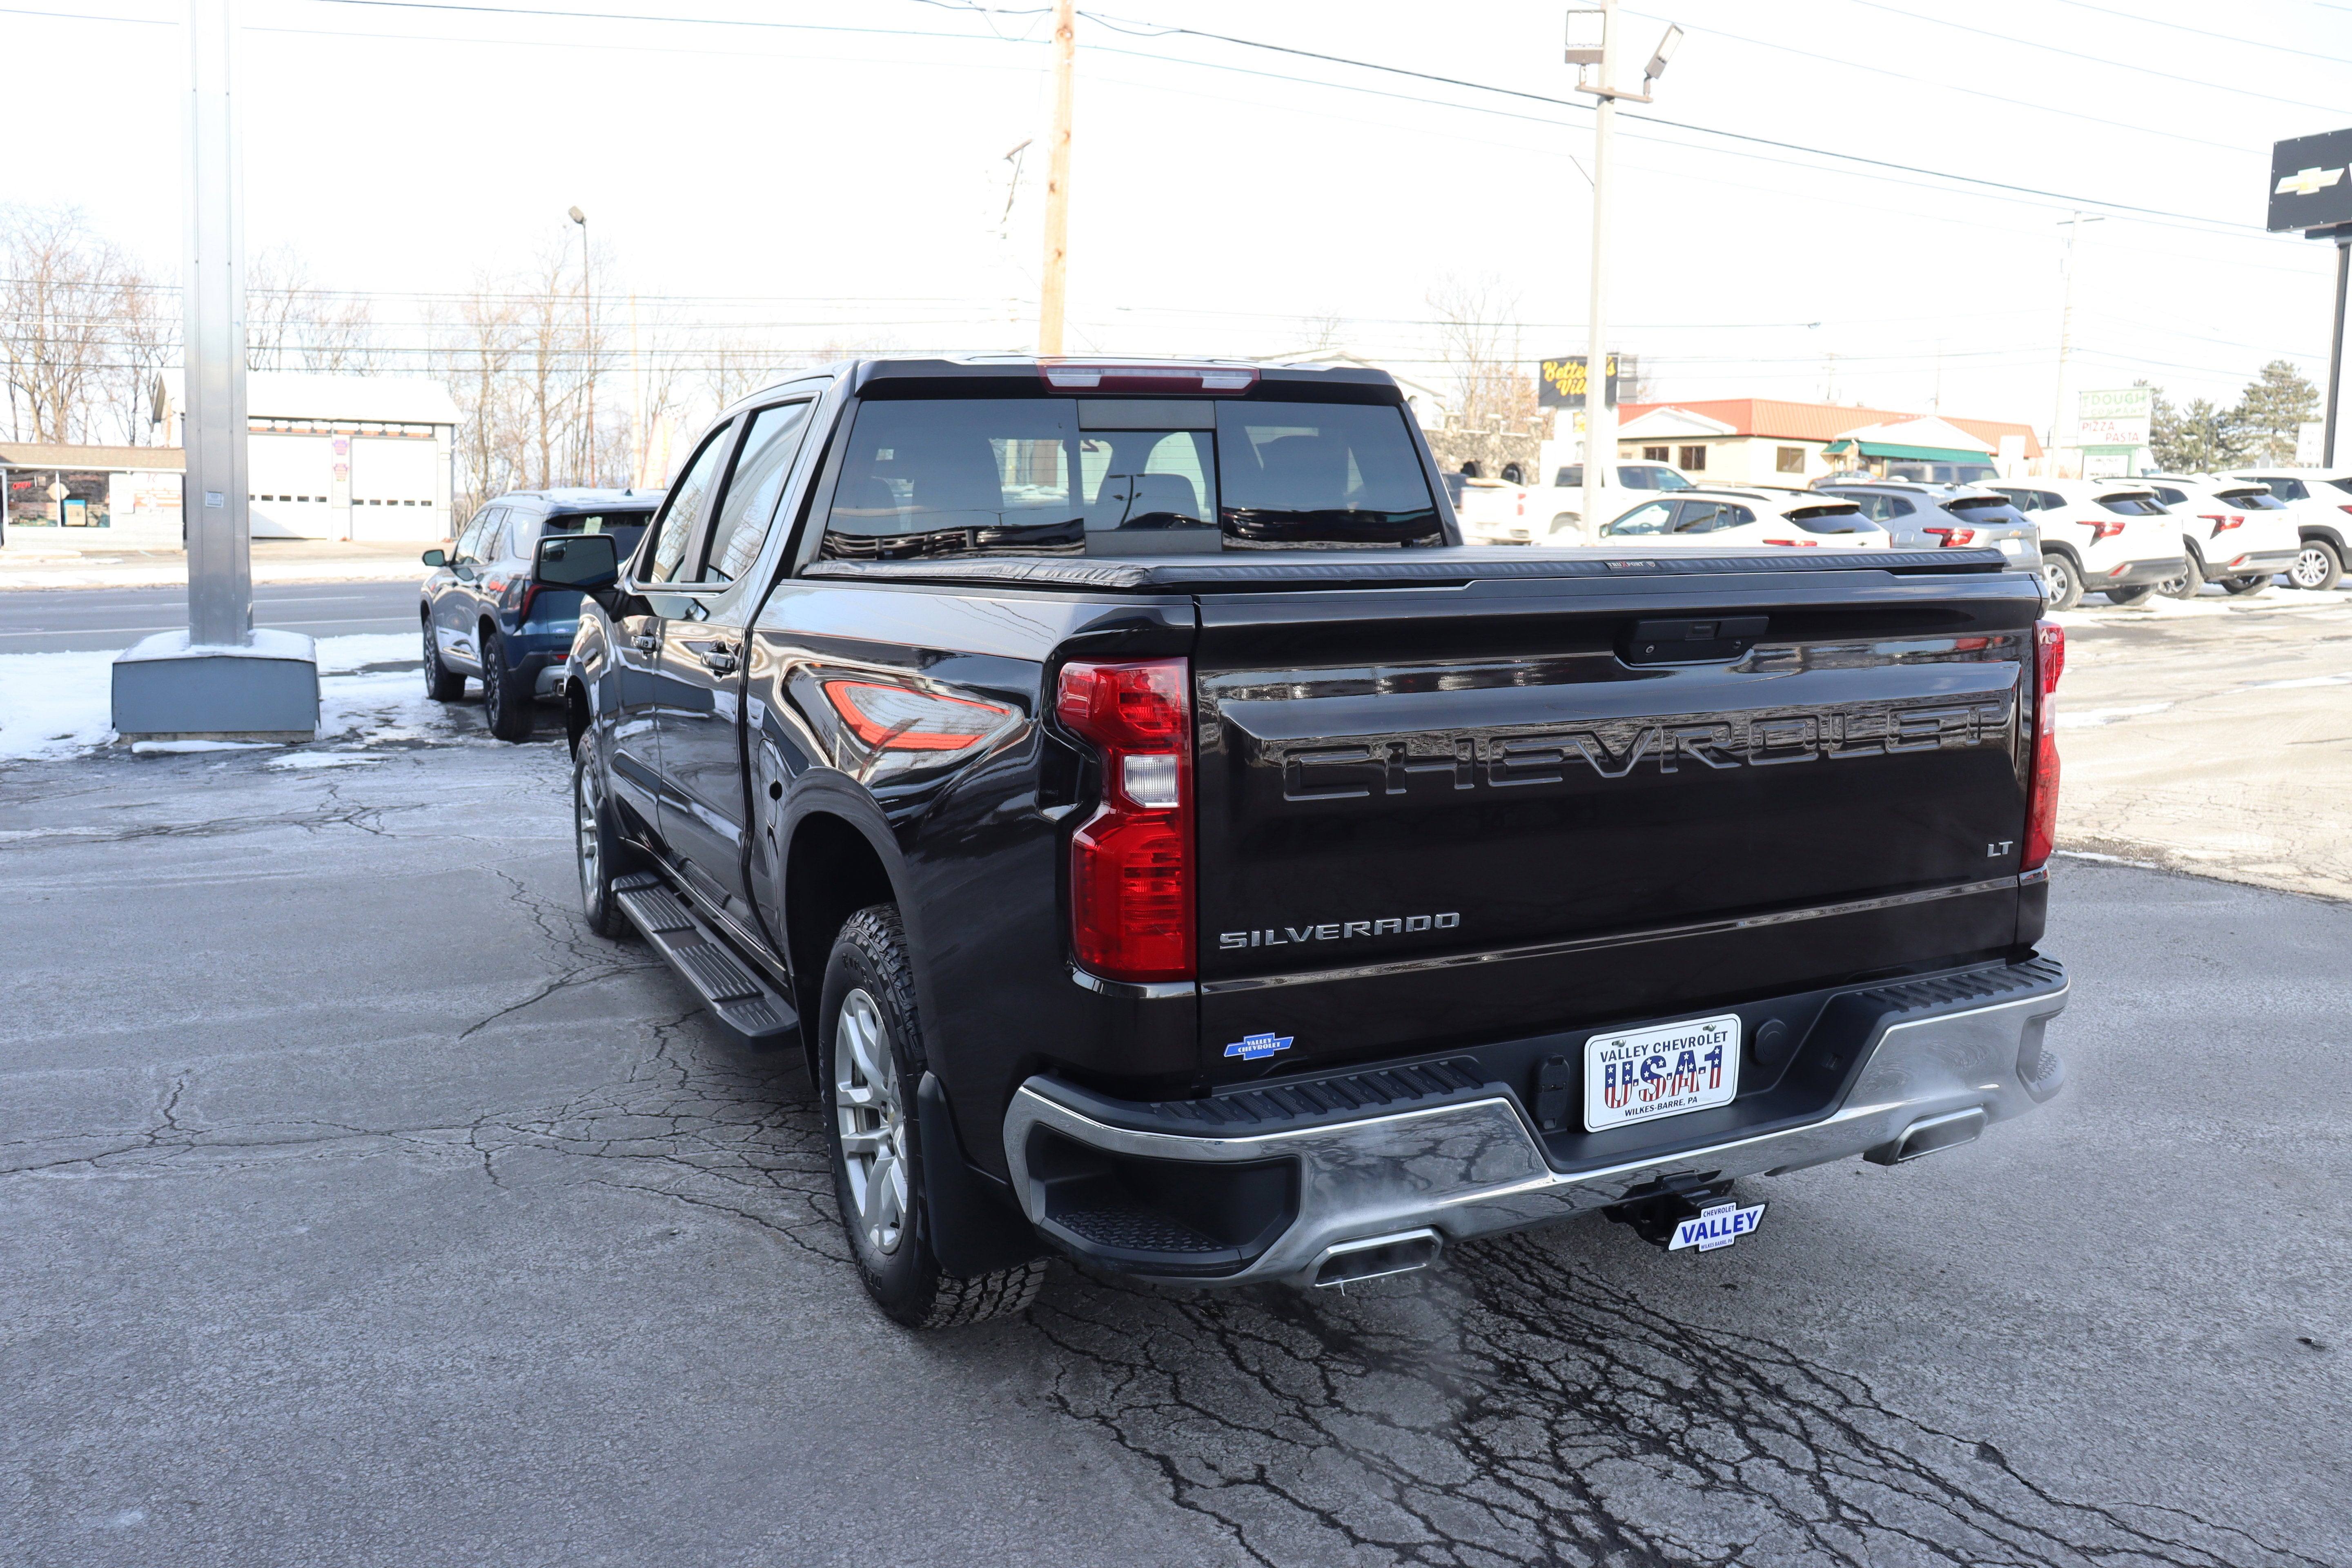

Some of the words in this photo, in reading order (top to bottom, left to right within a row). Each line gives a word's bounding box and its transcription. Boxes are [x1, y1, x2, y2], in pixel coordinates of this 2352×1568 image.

[2091, 392, 2147, 405] DOUGH
[2082, 421, 2114, 431] PIZZA
[2106, 432, 2138, 442] PASTA
[13, 481, 31, 490] OPEN
[1282, 699, 2005, 802] CHEVROLET
[1987, 841, 2013, 857] LT
[1220, 912, 1460, 949] SILVERADO
[1238, 1042, 1281, 1053] CHEVROLET
[1600, 1044, 1649, 1062] VALLEY
[1653, 1031, 1728, 1054] CHEVROLET
[1625, 1099, 1685, 1117] WILKES-BARRE,
[1688, 1096, 1697, 1105] PA
[1703, 1205, 1735, 1217] CHEVROLET
[1682, 1210, 1758, 1244] VALLEY
